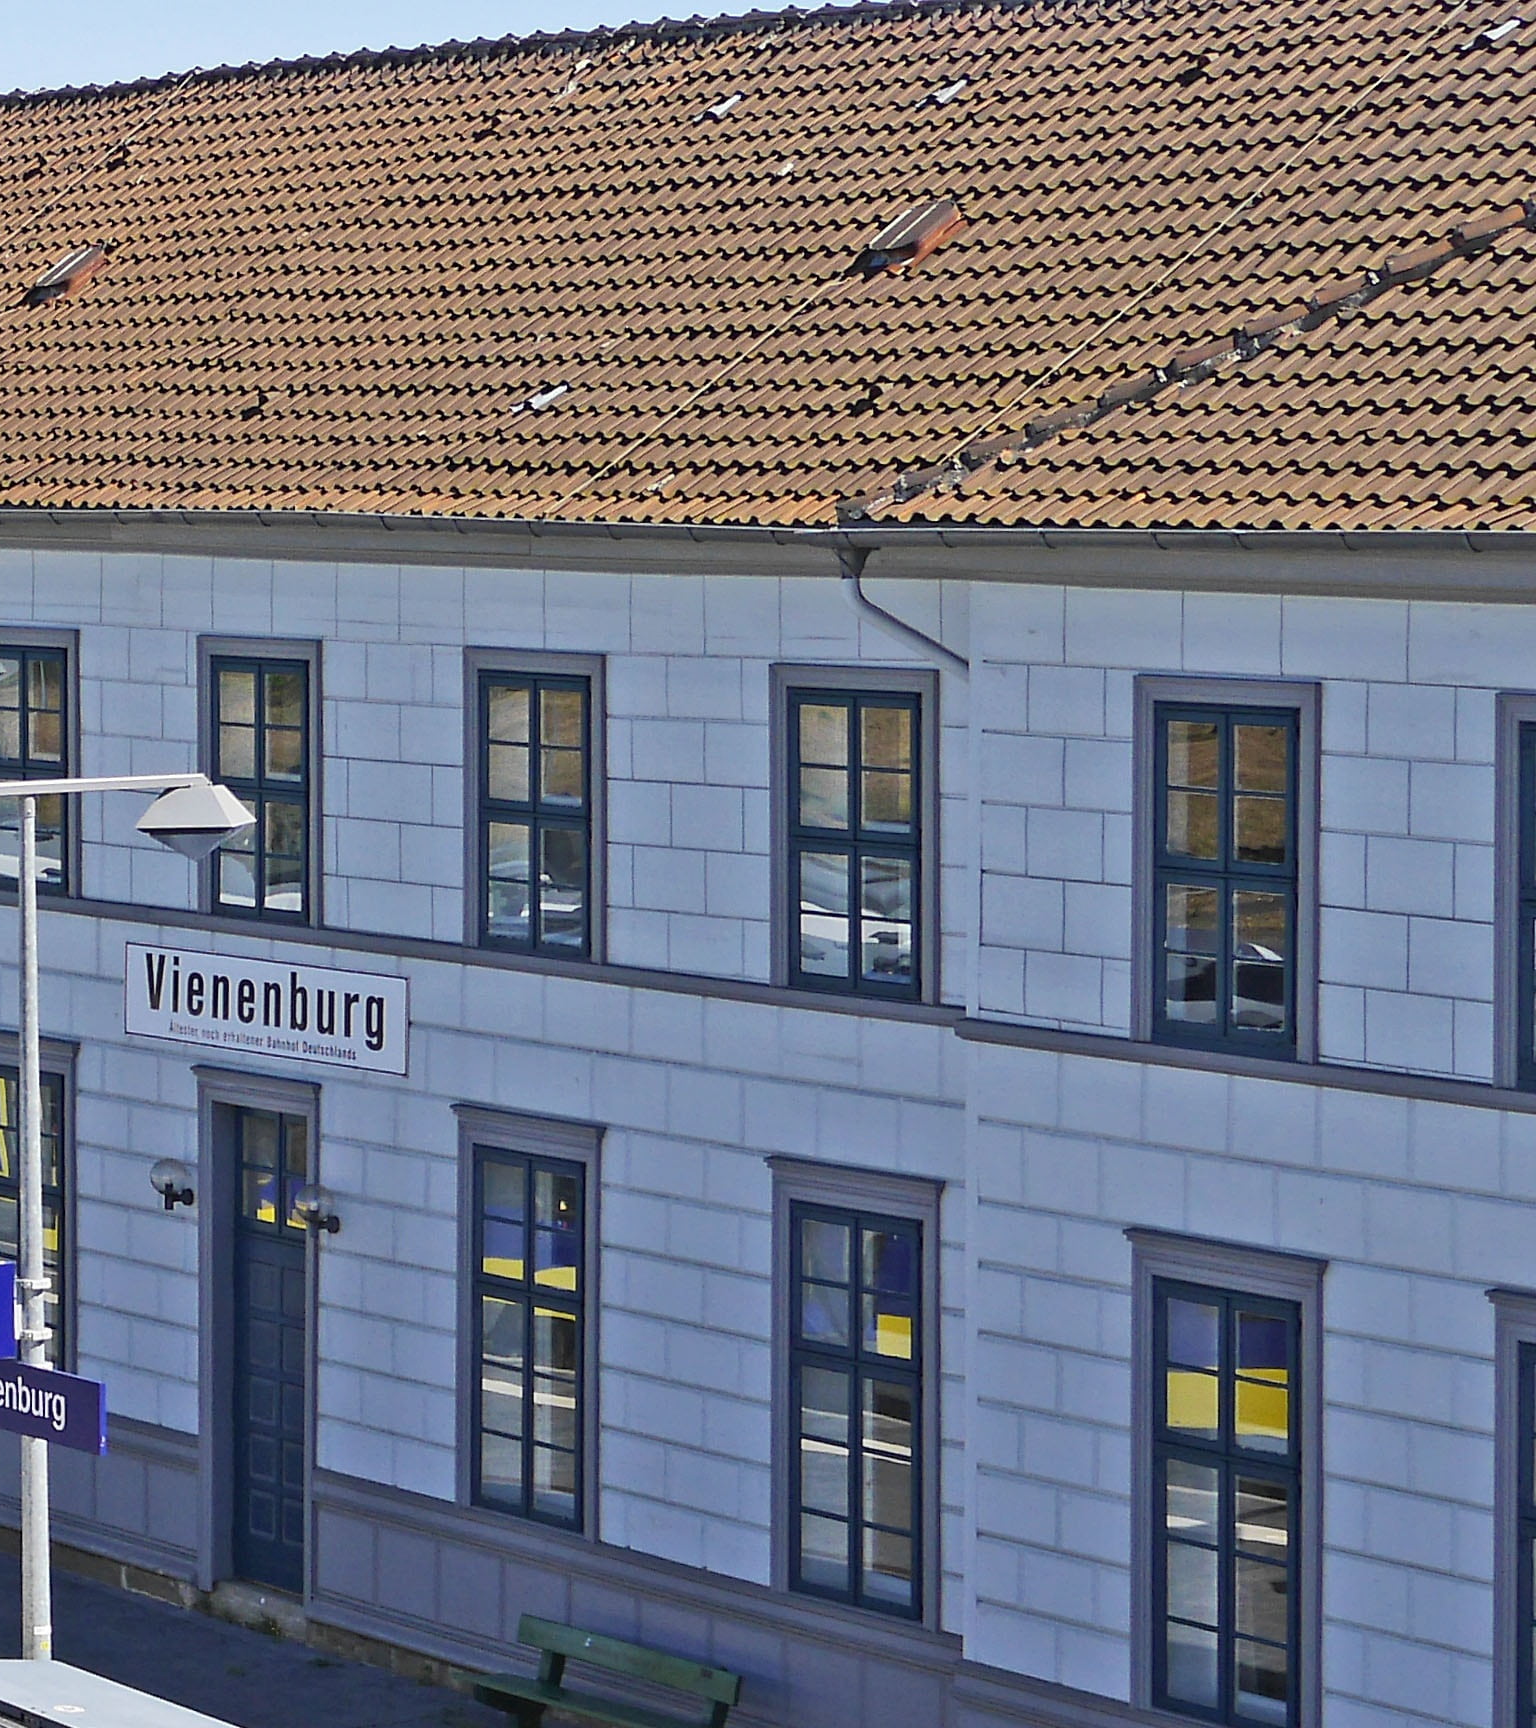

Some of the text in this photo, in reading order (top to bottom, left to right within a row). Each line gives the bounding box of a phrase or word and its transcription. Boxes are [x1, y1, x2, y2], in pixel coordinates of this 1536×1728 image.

[144, 952, 385, 1051] Vienenburg
[266, 1035, 300, 1053] Bahnhof
[302, 1040, 358, 1061] Deutschlands
